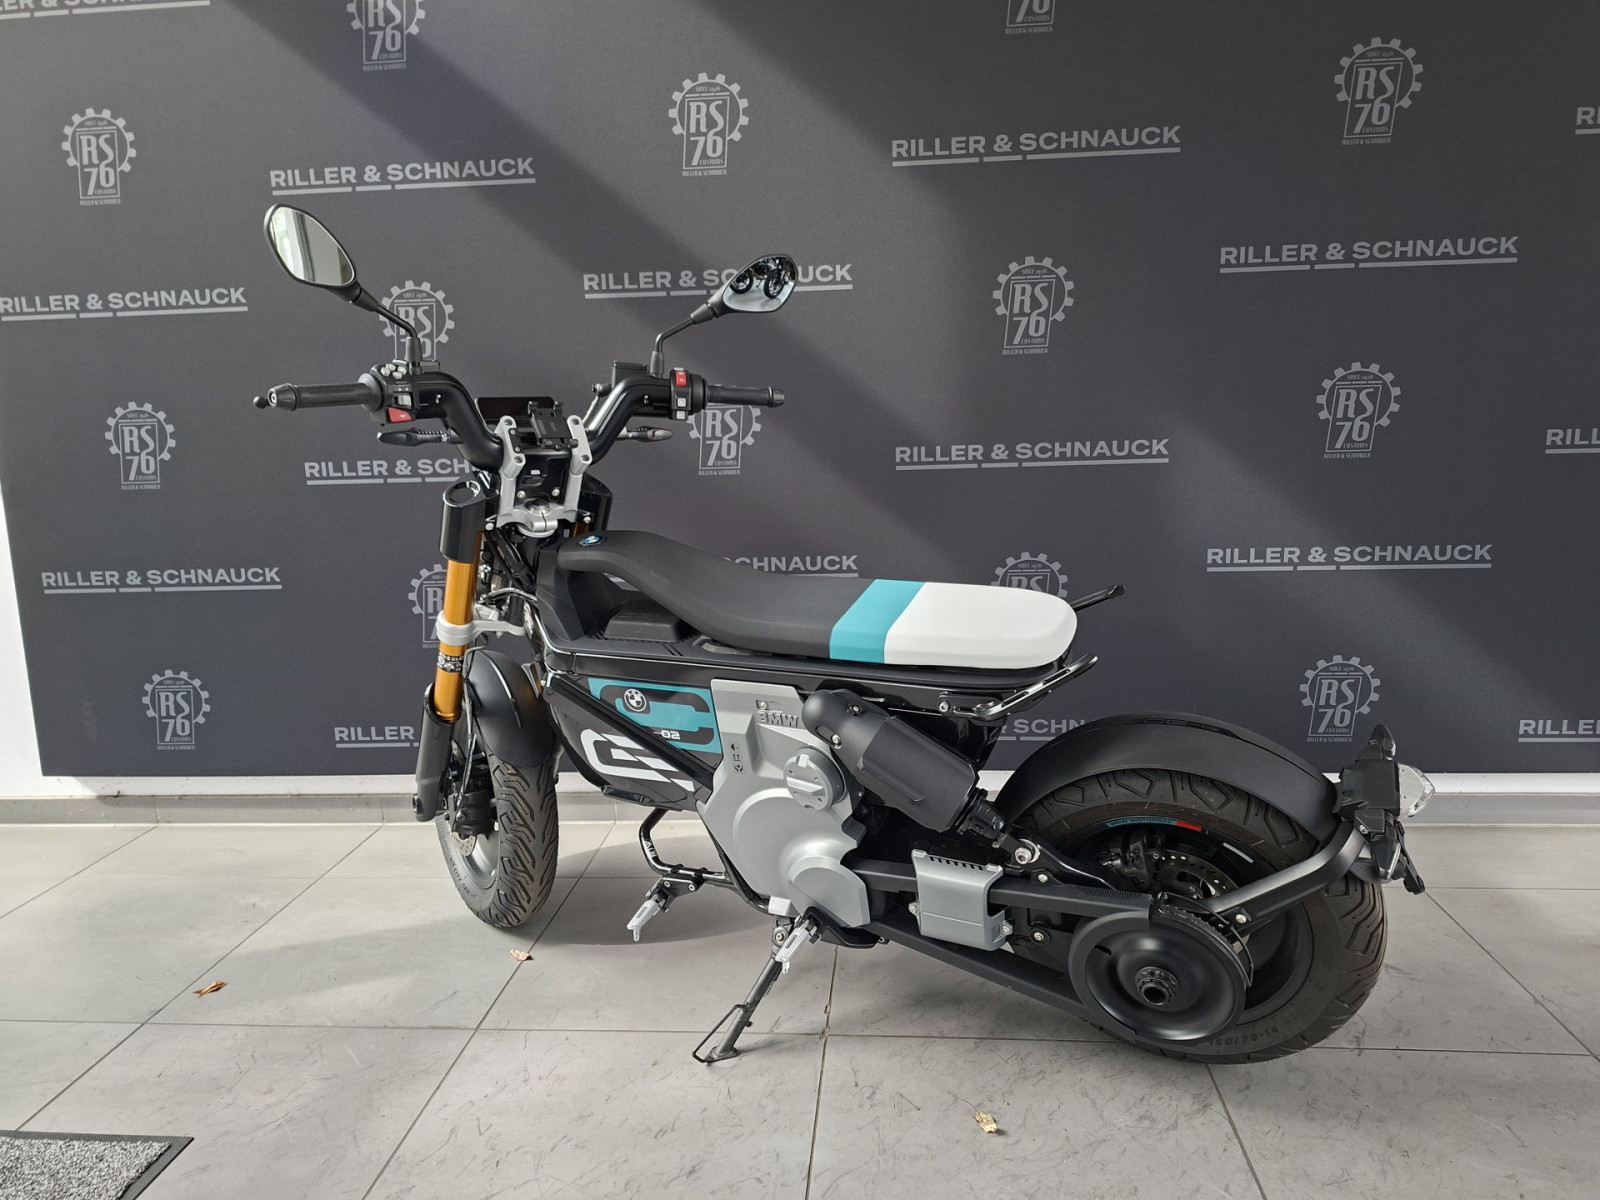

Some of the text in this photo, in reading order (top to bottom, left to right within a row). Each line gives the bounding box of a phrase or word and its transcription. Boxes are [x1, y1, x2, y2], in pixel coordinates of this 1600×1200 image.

[369, 26, 402, 60] 76
[1355, 66, 1394, 99] RS
[689, 100, 724, 133] RS
[1353, 97, 1391, 133] 76
[79, 134, 114, 165] RS
[690, 131, 723, 166] 76
[892, 126, 1181, 158] RILLER & SCHNAUCK
[84, 161, 115, 196] 76
[270, 157, 535, 187] RILLER & SCHNAUCK
[1220, 236, 1519, 265] RILLER & SCHNAUCK
[583, 264, 853, 291] RILLER & SCUCK
[0, 287, 247, 313] RILLER & SCHNAUCK
[1013, 282, 1049, 314] RS
[1013, 310, 1046, 344] 76
[1336, 388, 1374, 418] RS
[705, 409, 738, 438] RS
[1335, 415, 1370, 449] 76
[122, 425, 155, 453] RS
[706, 436, 737, 467] 76
[895, 438, 1169, 463] RILLER & SCHNAUCK
[125, 450, 155, 481] 76
[304, 460, 389, 478] RILLER
[394, 459, 412, 475] &
[723, 554, 859, 572] HNAUCK
[1206, 544, 1493, 565] RILLER & SCHNAUCK
[41, 567, 282, 587] RILLER & SCHNAUCK
[159, 691, 190, 717] RS
[1319, 679, 1355, 706] RS
[162, 715, 190, 742] 76
[758, 711, 799, 727] BMW
[1318, 703, 1351, 733] 76
[1518, 719, 1600, 735] RILLE
[333, 725, 415, 741] RILLER
[661, 730, 681, 740] 02
